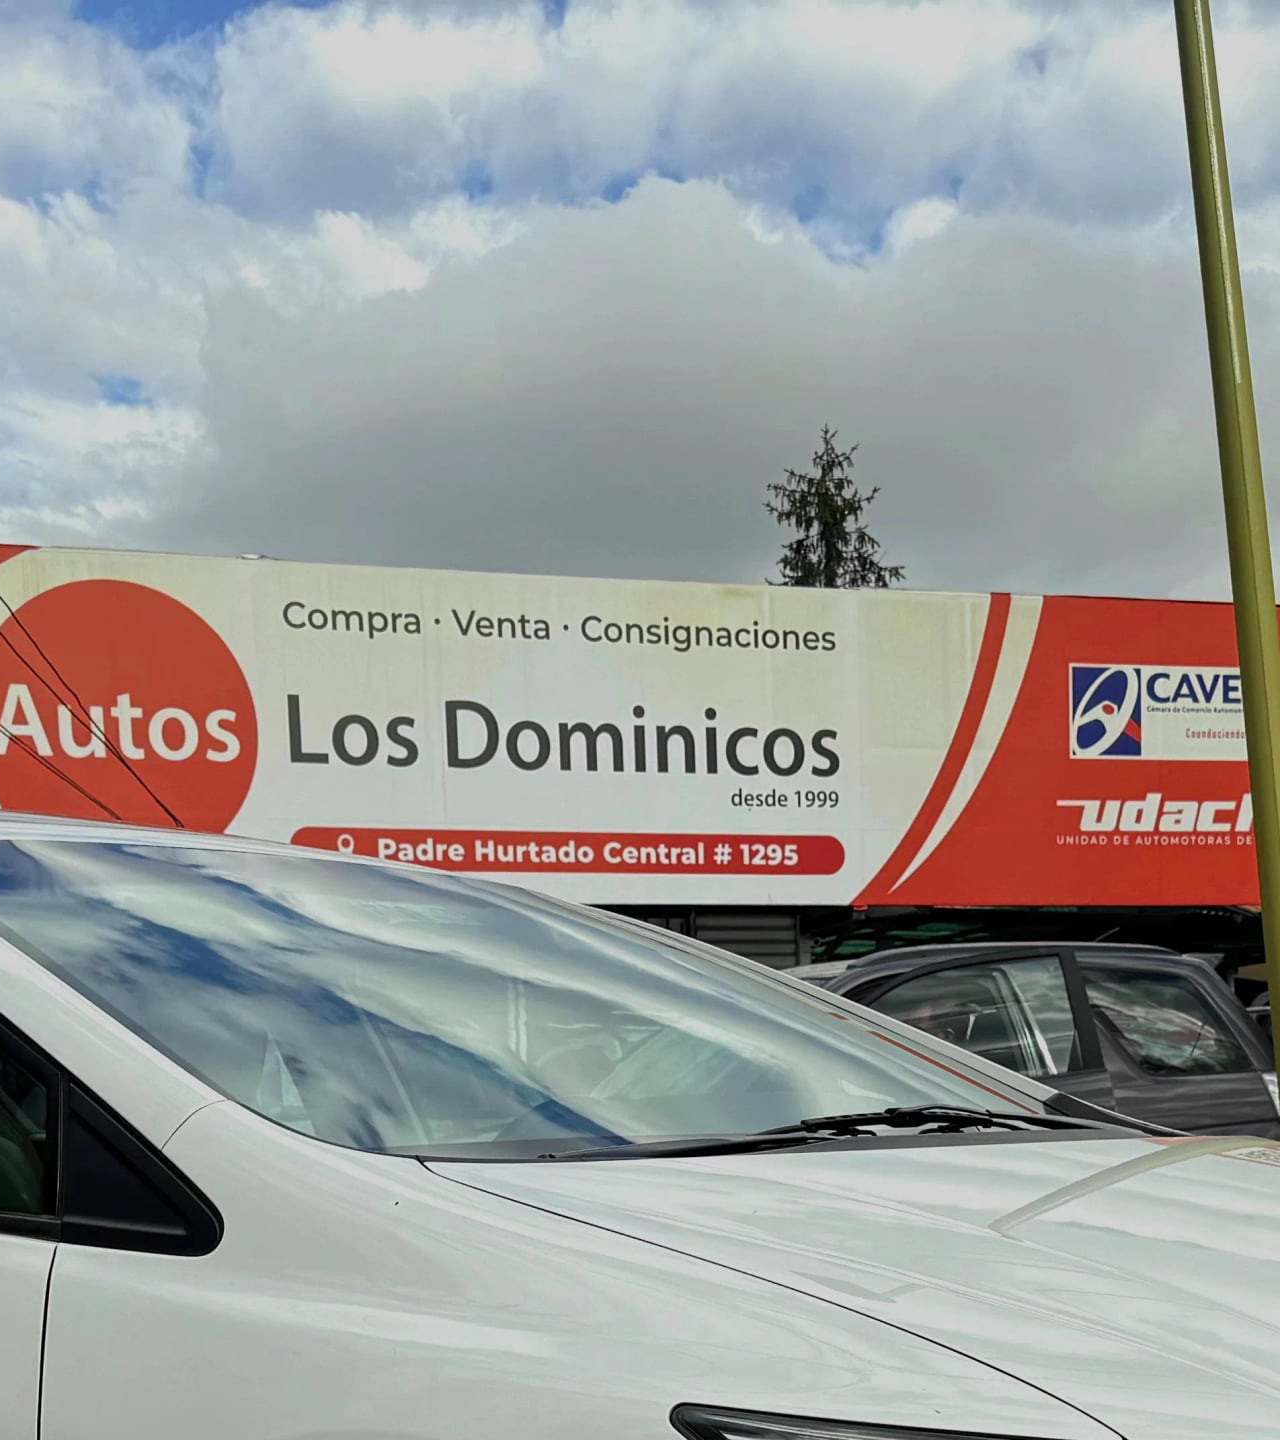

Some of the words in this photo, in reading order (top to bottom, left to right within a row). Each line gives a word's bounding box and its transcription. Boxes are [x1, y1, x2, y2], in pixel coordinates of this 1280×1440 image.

[282, 601, 421, 640] Compra
[451, 608, 551, 641] Venta
[580, 615, 837, 653] Consignaciones
[1172, 705, 1181, 714] de
[286, 693, 419, 768] Los
[444, 700, 841, 777] Dominicos
[730, 787, 788, 808] desde
[794, 790, 840, 809] 1999
[377, 837, 466, 863] Padre
[474, 839, 595, 864] Hurtado
[602, 841, 705, 865] Central
[713, 843, 733, 865] #
[739, 843, 799, 866] 1295
[1056, 835, 1108, 846] UNIDAD
[1113, 835, 1130, 846] DE
[1135, 835, 1231, 846] AUTOMOTORAS
[1236, 835, 1252, 846] DE
